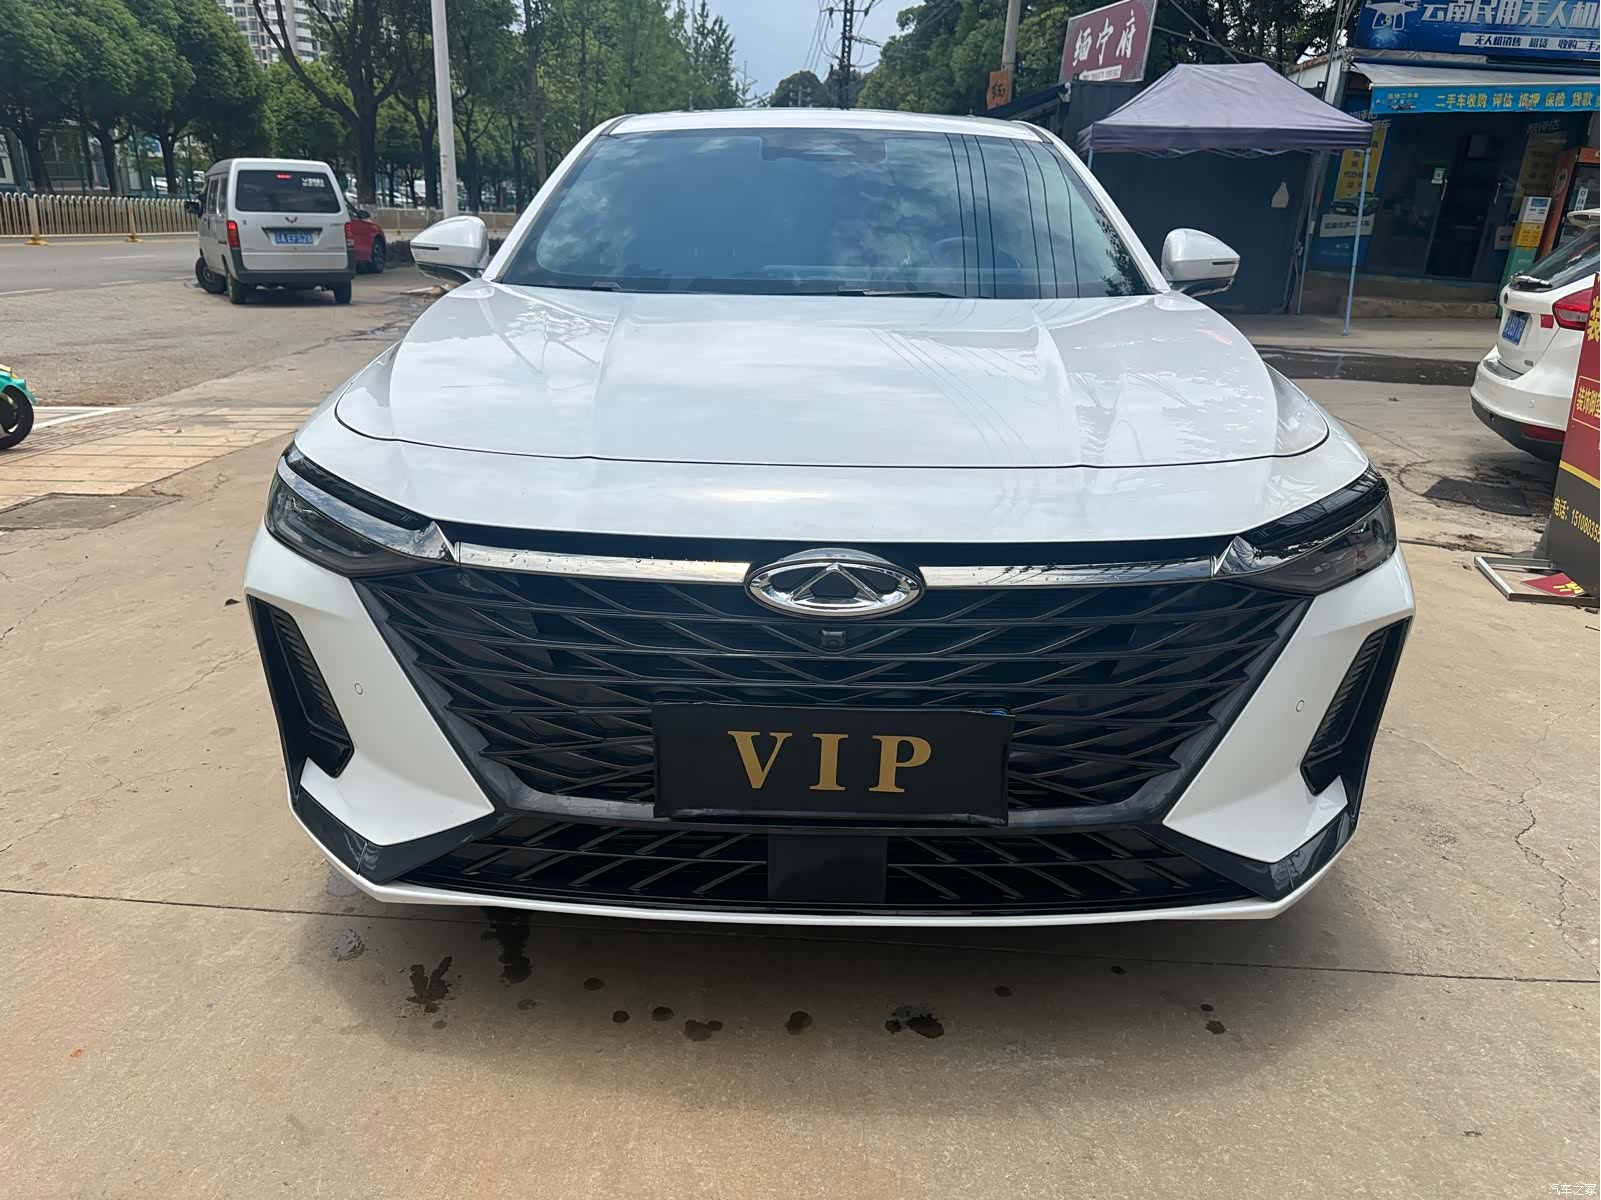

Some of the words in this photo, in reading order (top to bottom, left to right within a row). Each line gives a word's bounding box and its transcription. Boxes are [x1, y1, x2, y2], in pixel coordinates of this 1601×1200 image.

[1474, 35, 1522, 47] 无人机销售
[1528, 38, 1549, 49] 租赁
[1435, 93, 1487, 109] 二手车收购
[1492, 93, 1513, 108] 评估
[1518, 93, 1540, 108] 抵押
[1545, 92, 1565, 107] 保险
[1571, 92, 1594, 107] 贷款
[727, 730, 932, 793] VIP
